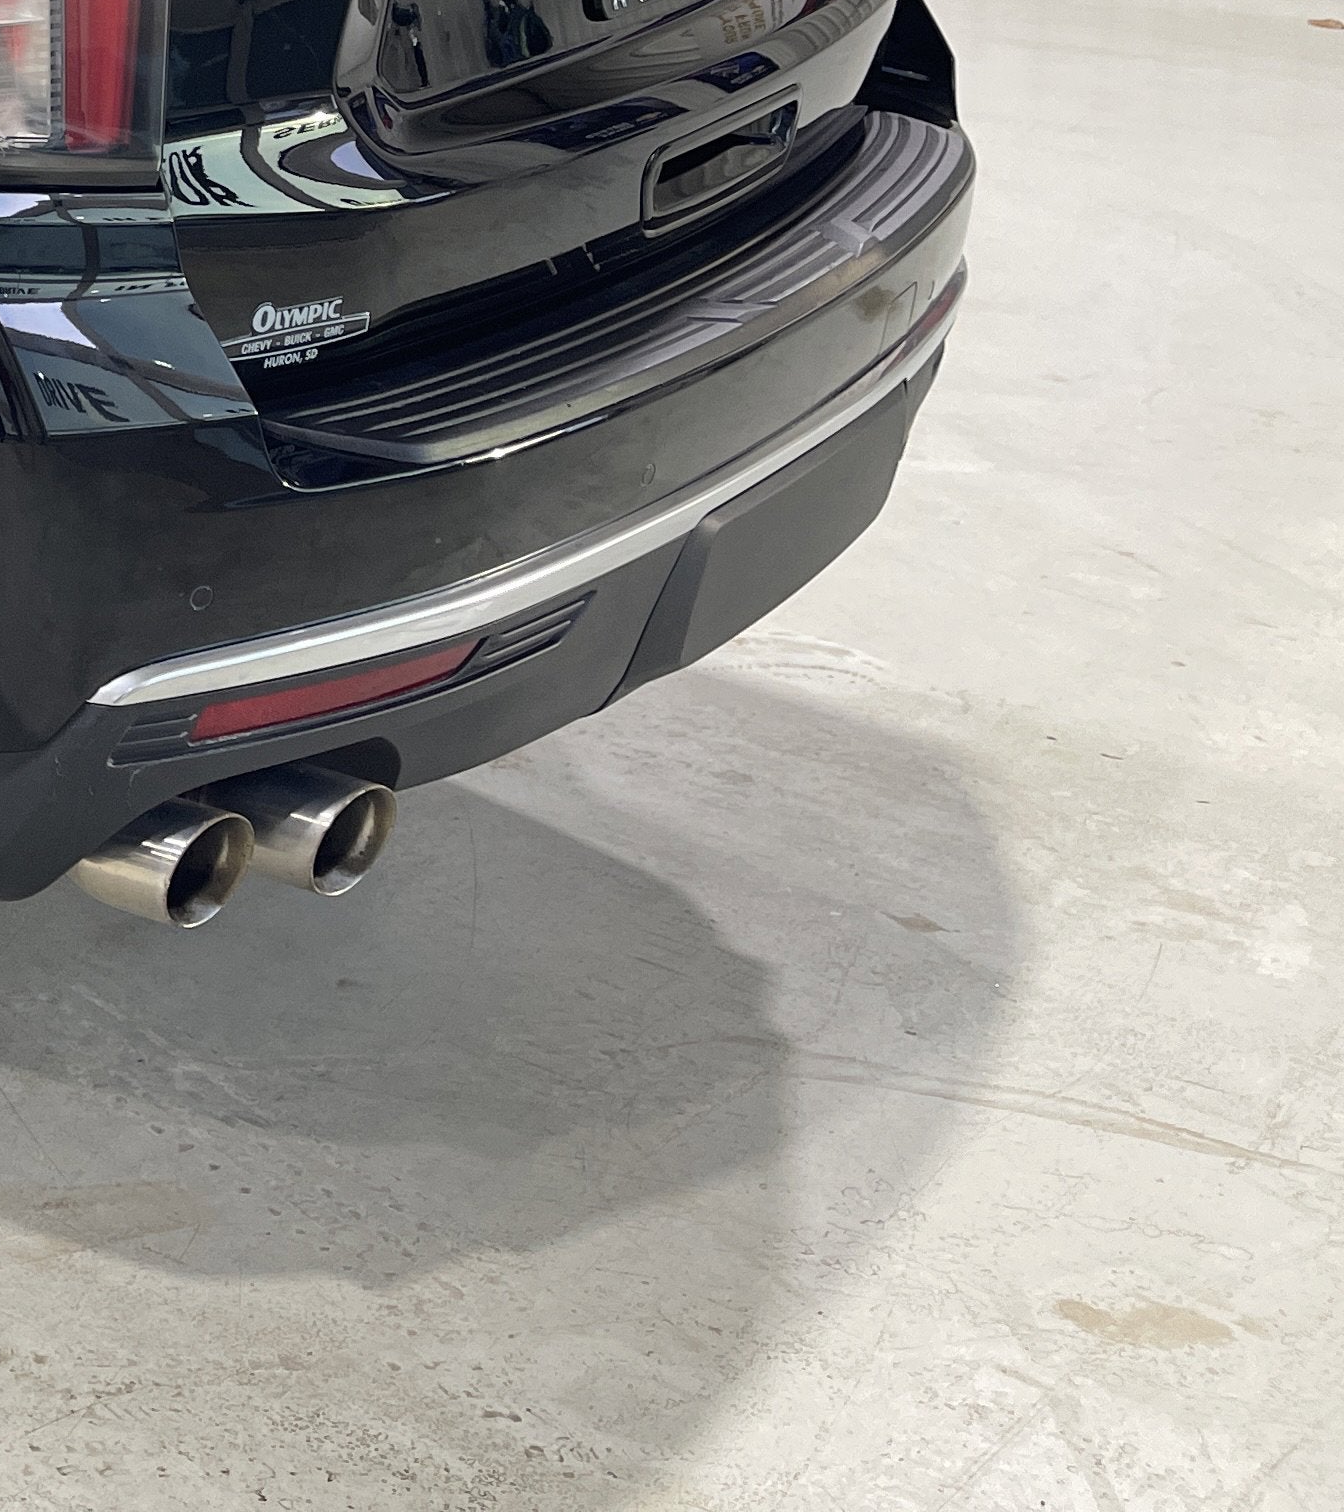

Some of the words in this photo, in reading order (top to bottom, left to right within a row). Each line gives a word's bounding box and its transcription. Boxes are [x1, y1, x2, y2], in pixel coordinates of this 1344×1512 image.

[252, 299, 343, 333] OLYMPIC
[241, 339, 273, 355] CHEVY
[283, 331, 313, 346] BUICK
[323, 324, 345, 338] GMC
[263, 352, 304, 369] HURON,
[305, 348, 319, 361] SD
